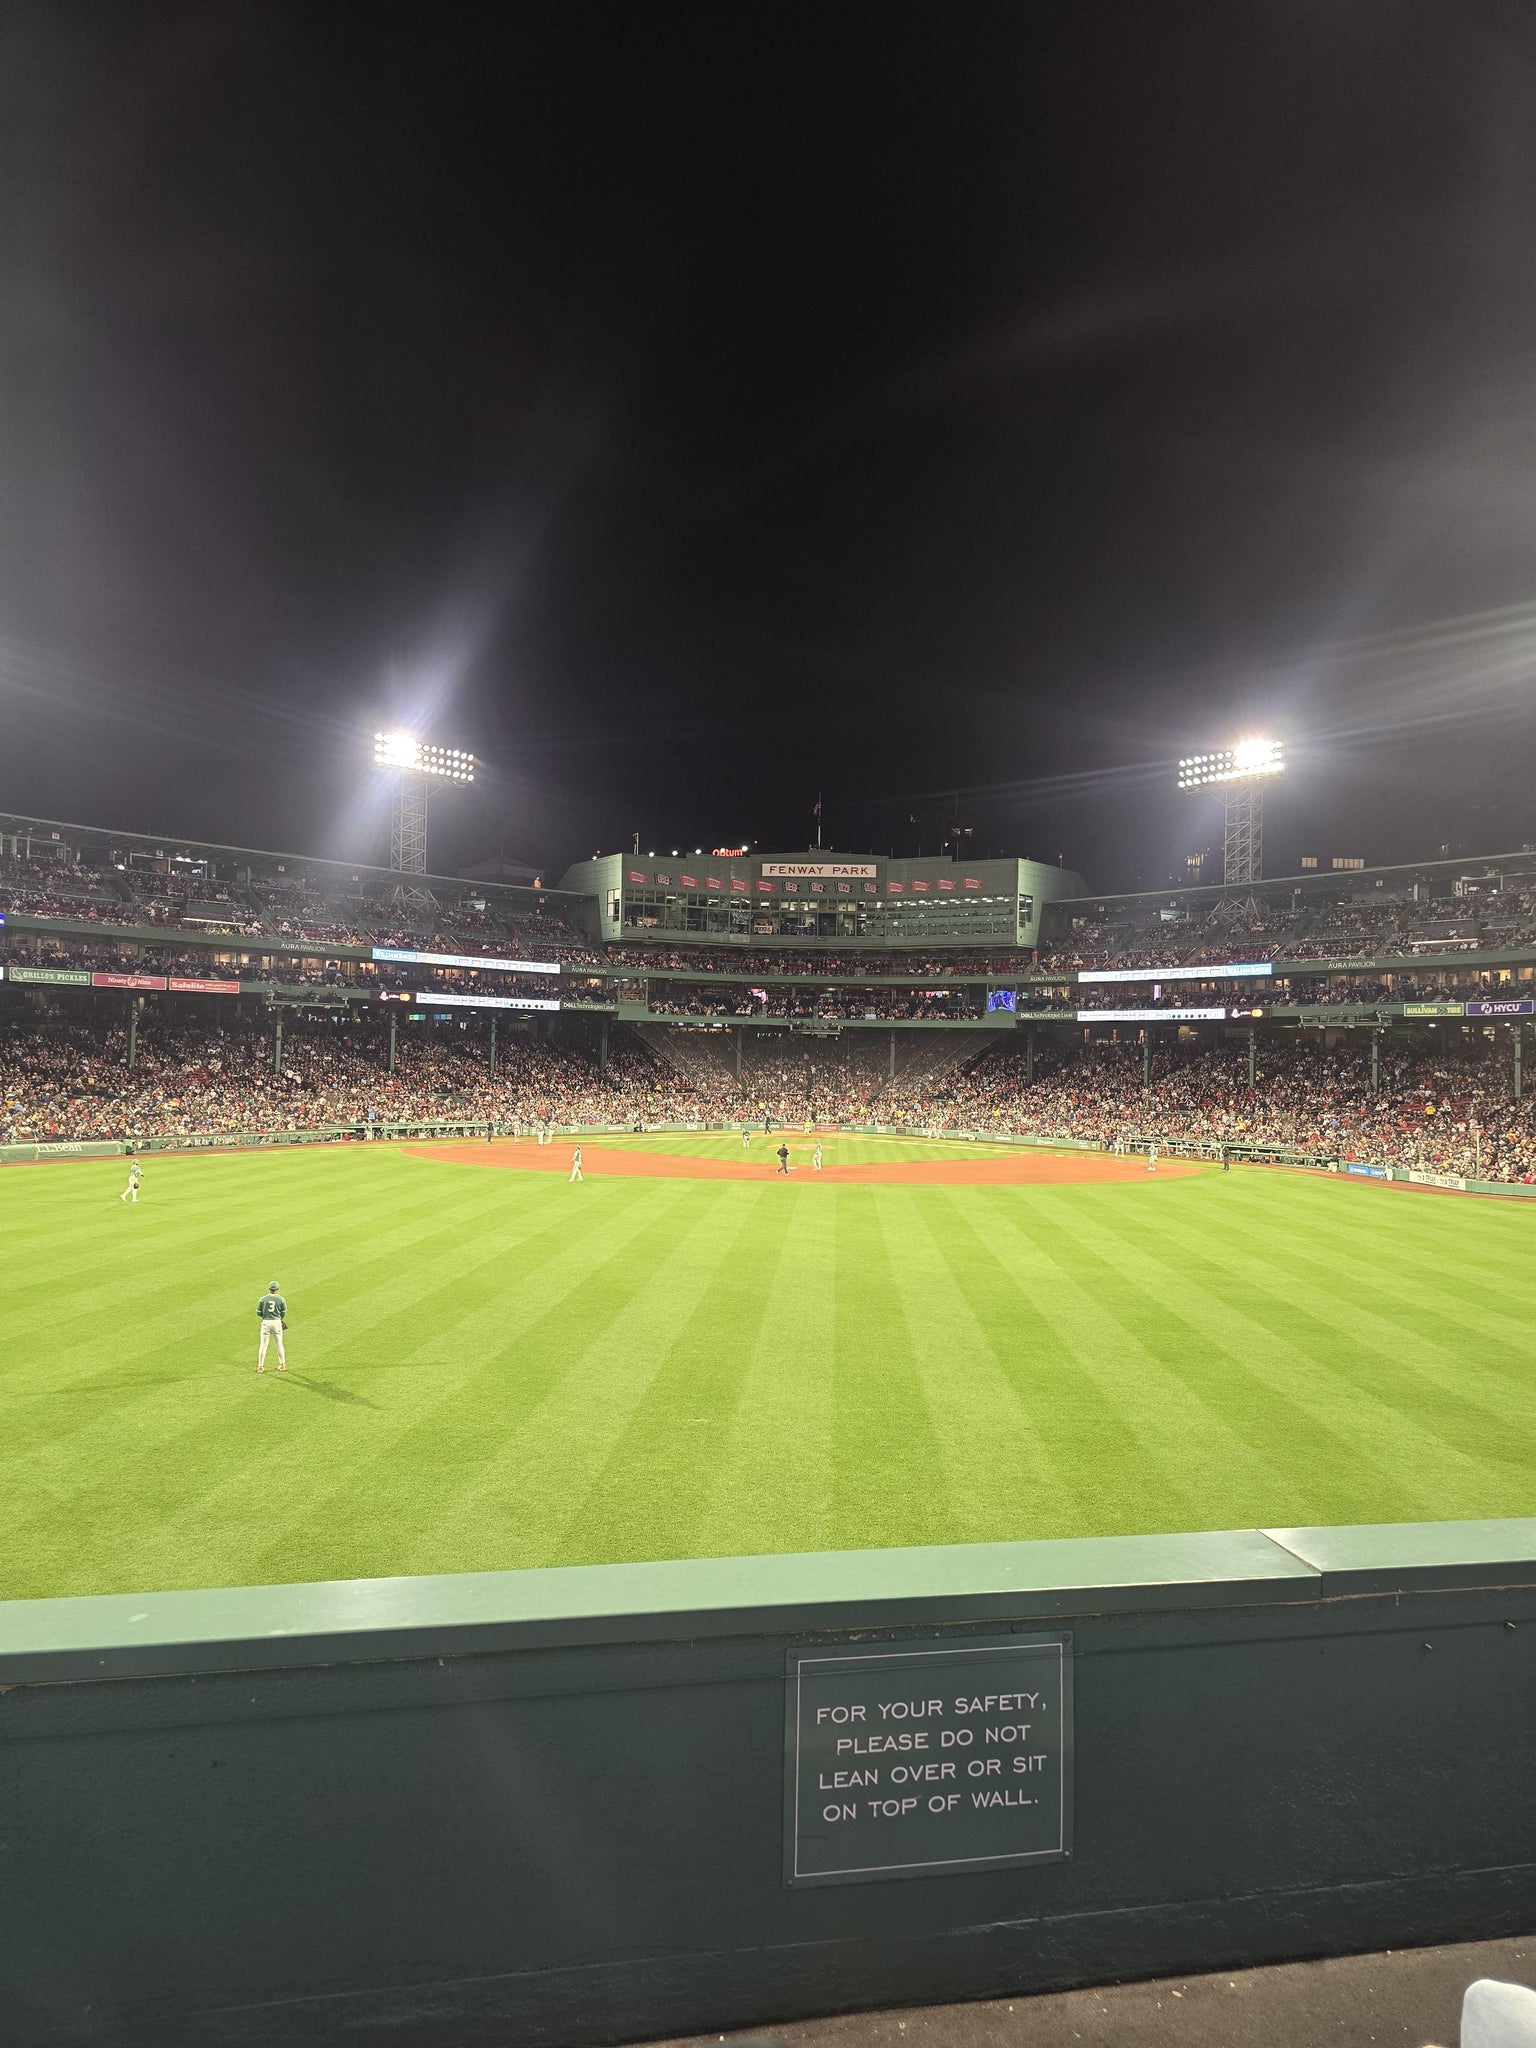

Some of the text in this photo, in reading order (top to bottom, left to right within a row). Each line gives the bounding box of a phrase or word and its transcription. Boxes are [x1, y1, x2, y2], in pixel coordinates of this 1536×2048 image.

[769, 866, 868, 875] FENWAY PARK
[300, 944, 326, 952] PAVILION
[23, 971, 88, 982] GRILLO'S PICKLES
[1406, 1006, 1461, 1014] SULLIVAN TIRE
[1494, 1004, 1520, 1012] HYCU
[267, 1301, 276, 1313] 3
[817, 1692, 1047, 1725] FOR YOUR SAFETY,
[836, 1725, 1032, 1755] PLEASE DO NOT
[819, 1754, 1048, 1790] LEAN OVER OR SIT
[822, 1788, 1039, 1822] ON TOP OF WALL.
